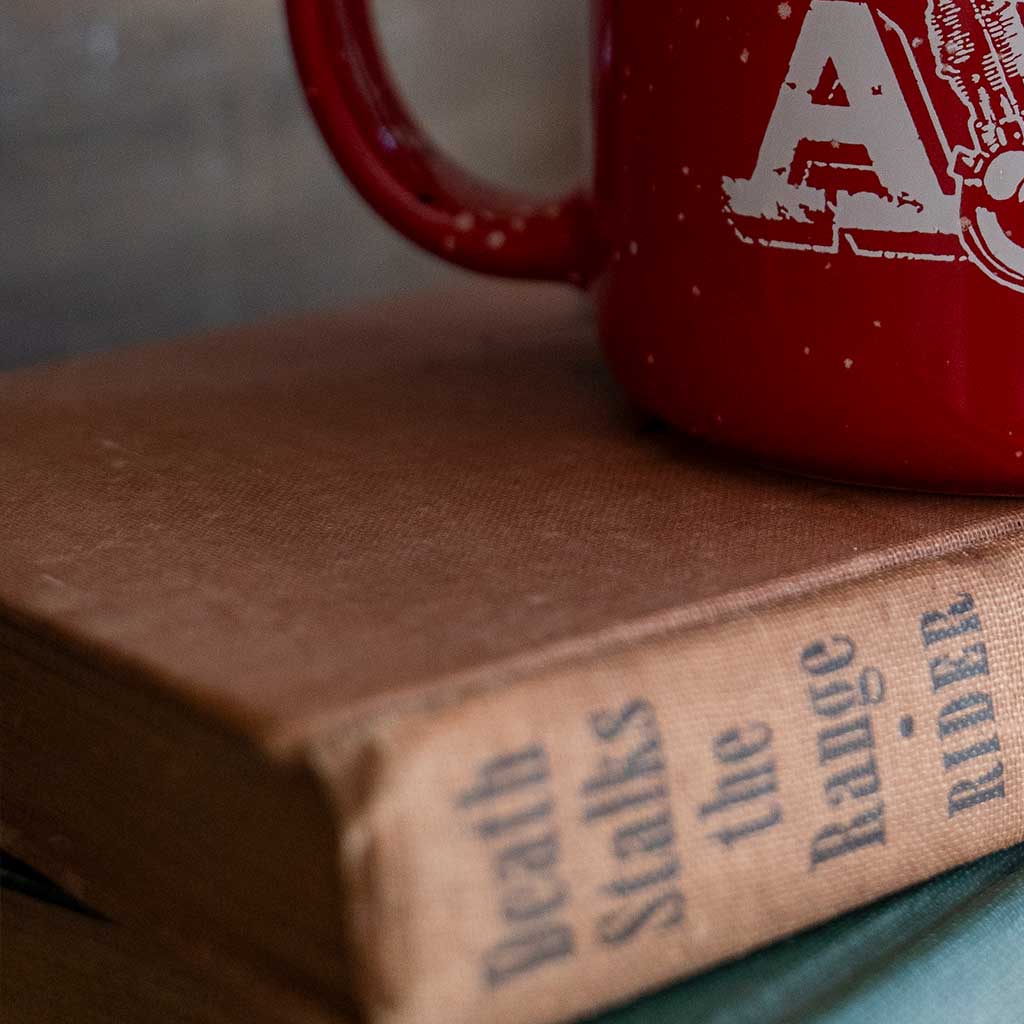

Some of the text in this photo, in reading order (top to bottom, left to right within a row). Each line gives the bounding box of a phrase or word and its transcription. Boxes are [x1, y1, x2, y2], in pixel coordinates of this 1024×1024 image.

[581, 696, 687, 946] Stalks
[699, 720, 785, 849] the
[801, 632, 887, 871] Range
[921, 591, 1007, 818] RIDER
[456, 740, 576, 990] Death
